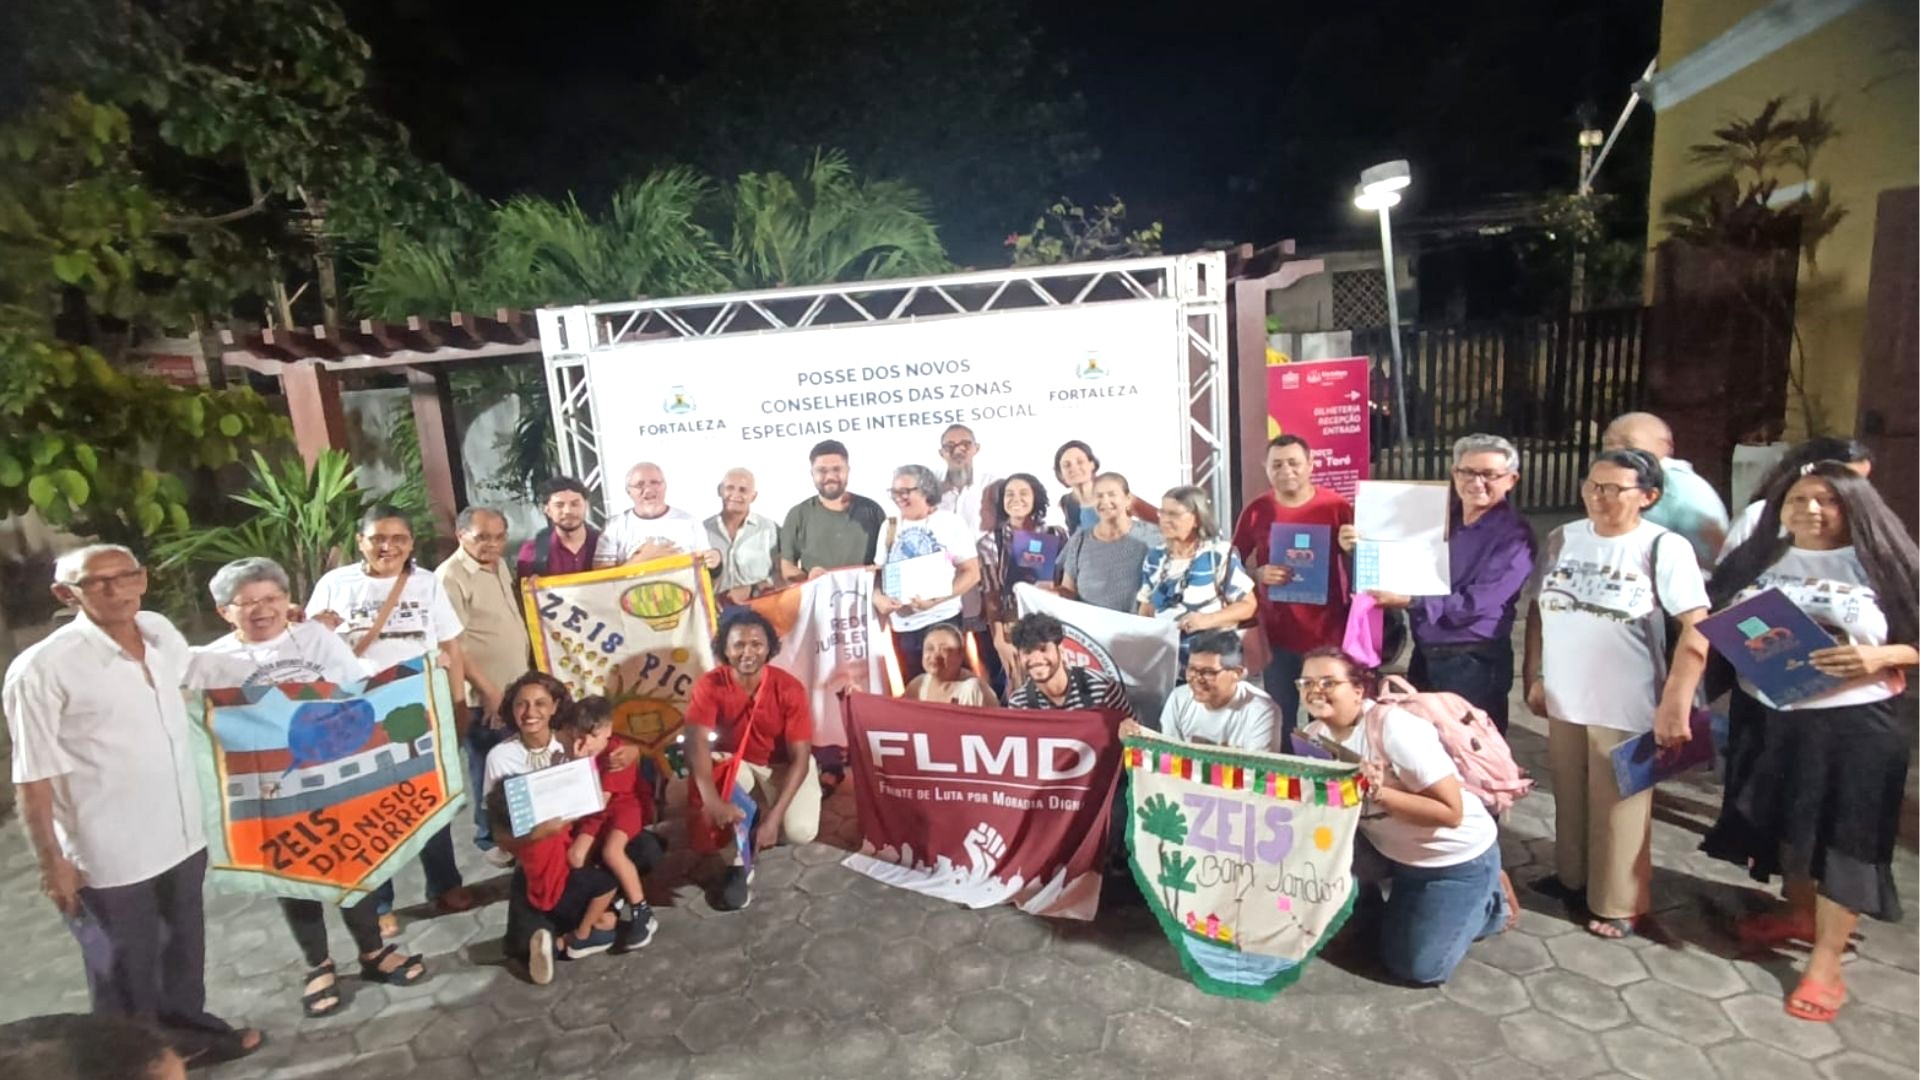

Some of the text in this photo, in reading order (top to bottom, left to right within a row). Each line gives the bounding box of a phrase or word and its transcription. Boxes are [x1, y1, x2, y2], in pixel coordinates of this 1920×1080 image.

[797, 359, 971, 386] POSSE DOS NOVOS
[1049, 385, 1138, 401] FORTALEZA
[761, 380, 1013, 414] CONSELHEIROS DAS ZONAS
[639, 419, 726, 436] FORTALEZA
[742, 404, 1037, 440] ESPECIAIS DE INTERESSE SOCIAL
[540, 593, 625, 654] ZEIS
[640, 653, 692, 696] PIC
[866, 731, 1097, 780] FLMD
[1049, 796, 1080, 810] DIGN
[260, 808, 341, 871] ZEIS
[309, 780, 417, 876] DIONISIO
[351, 787, 438, 867] TORRES
[1183, 793, 1295, 865] ZEIS
